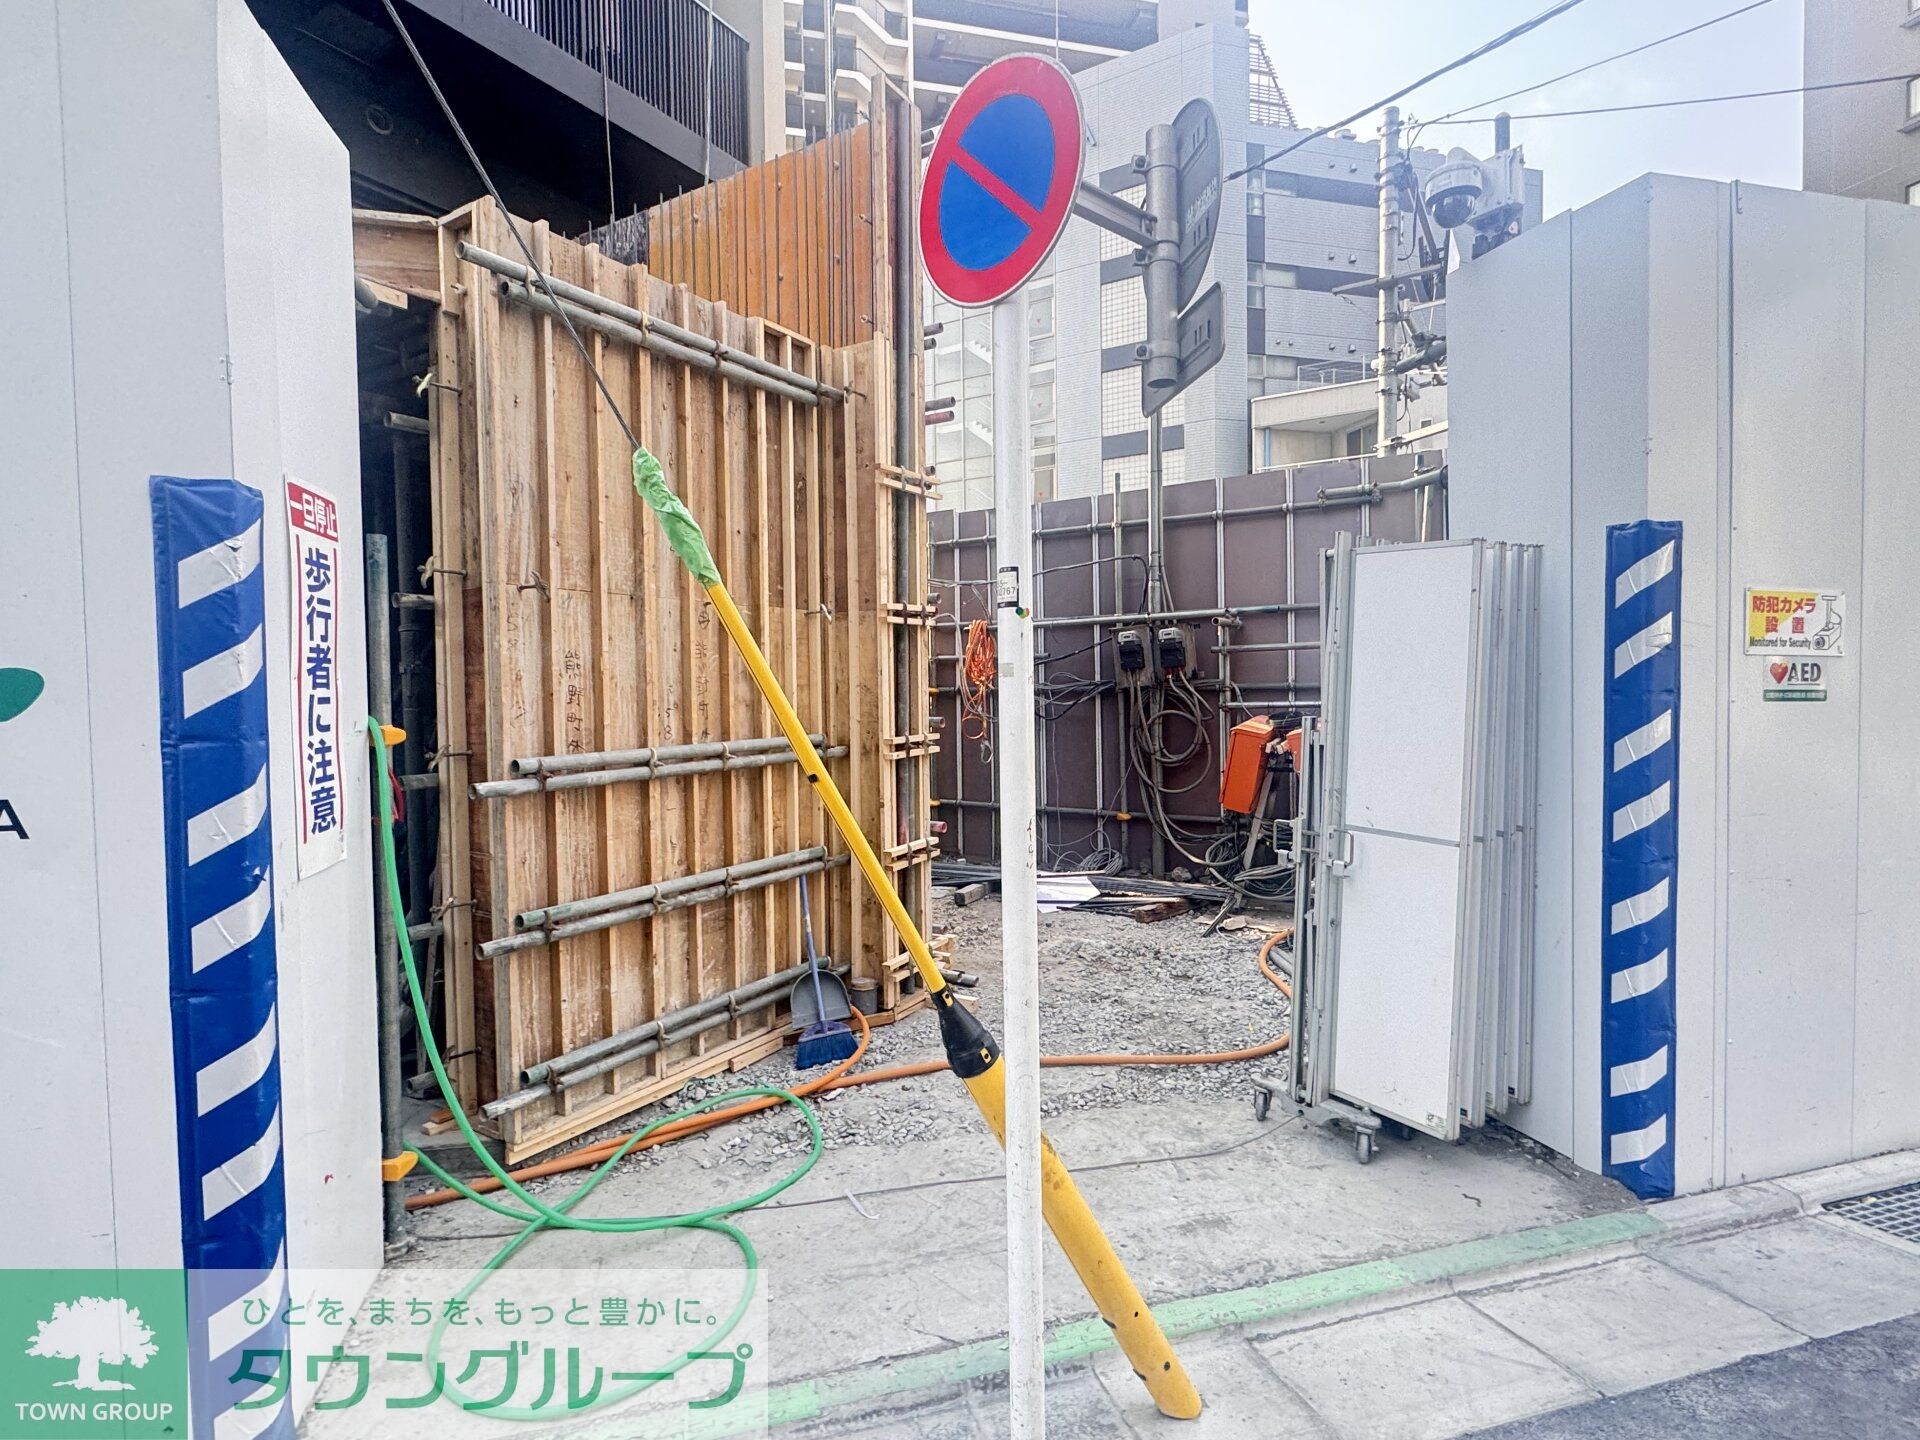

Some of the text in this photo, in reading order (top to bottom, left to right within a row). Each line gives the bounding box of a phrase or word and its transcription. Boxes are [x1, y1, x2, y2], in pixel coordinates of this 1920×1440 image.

[289, 492, 338, 538] 一旦停止
[1752, 595, 1816, 614] 防犯カメラ
[1749, 636, 1811, 650] Monitored for Security
[1787, 662, 1822, 682] AED
[304, 547, 337, 834] 歩行者に注意
